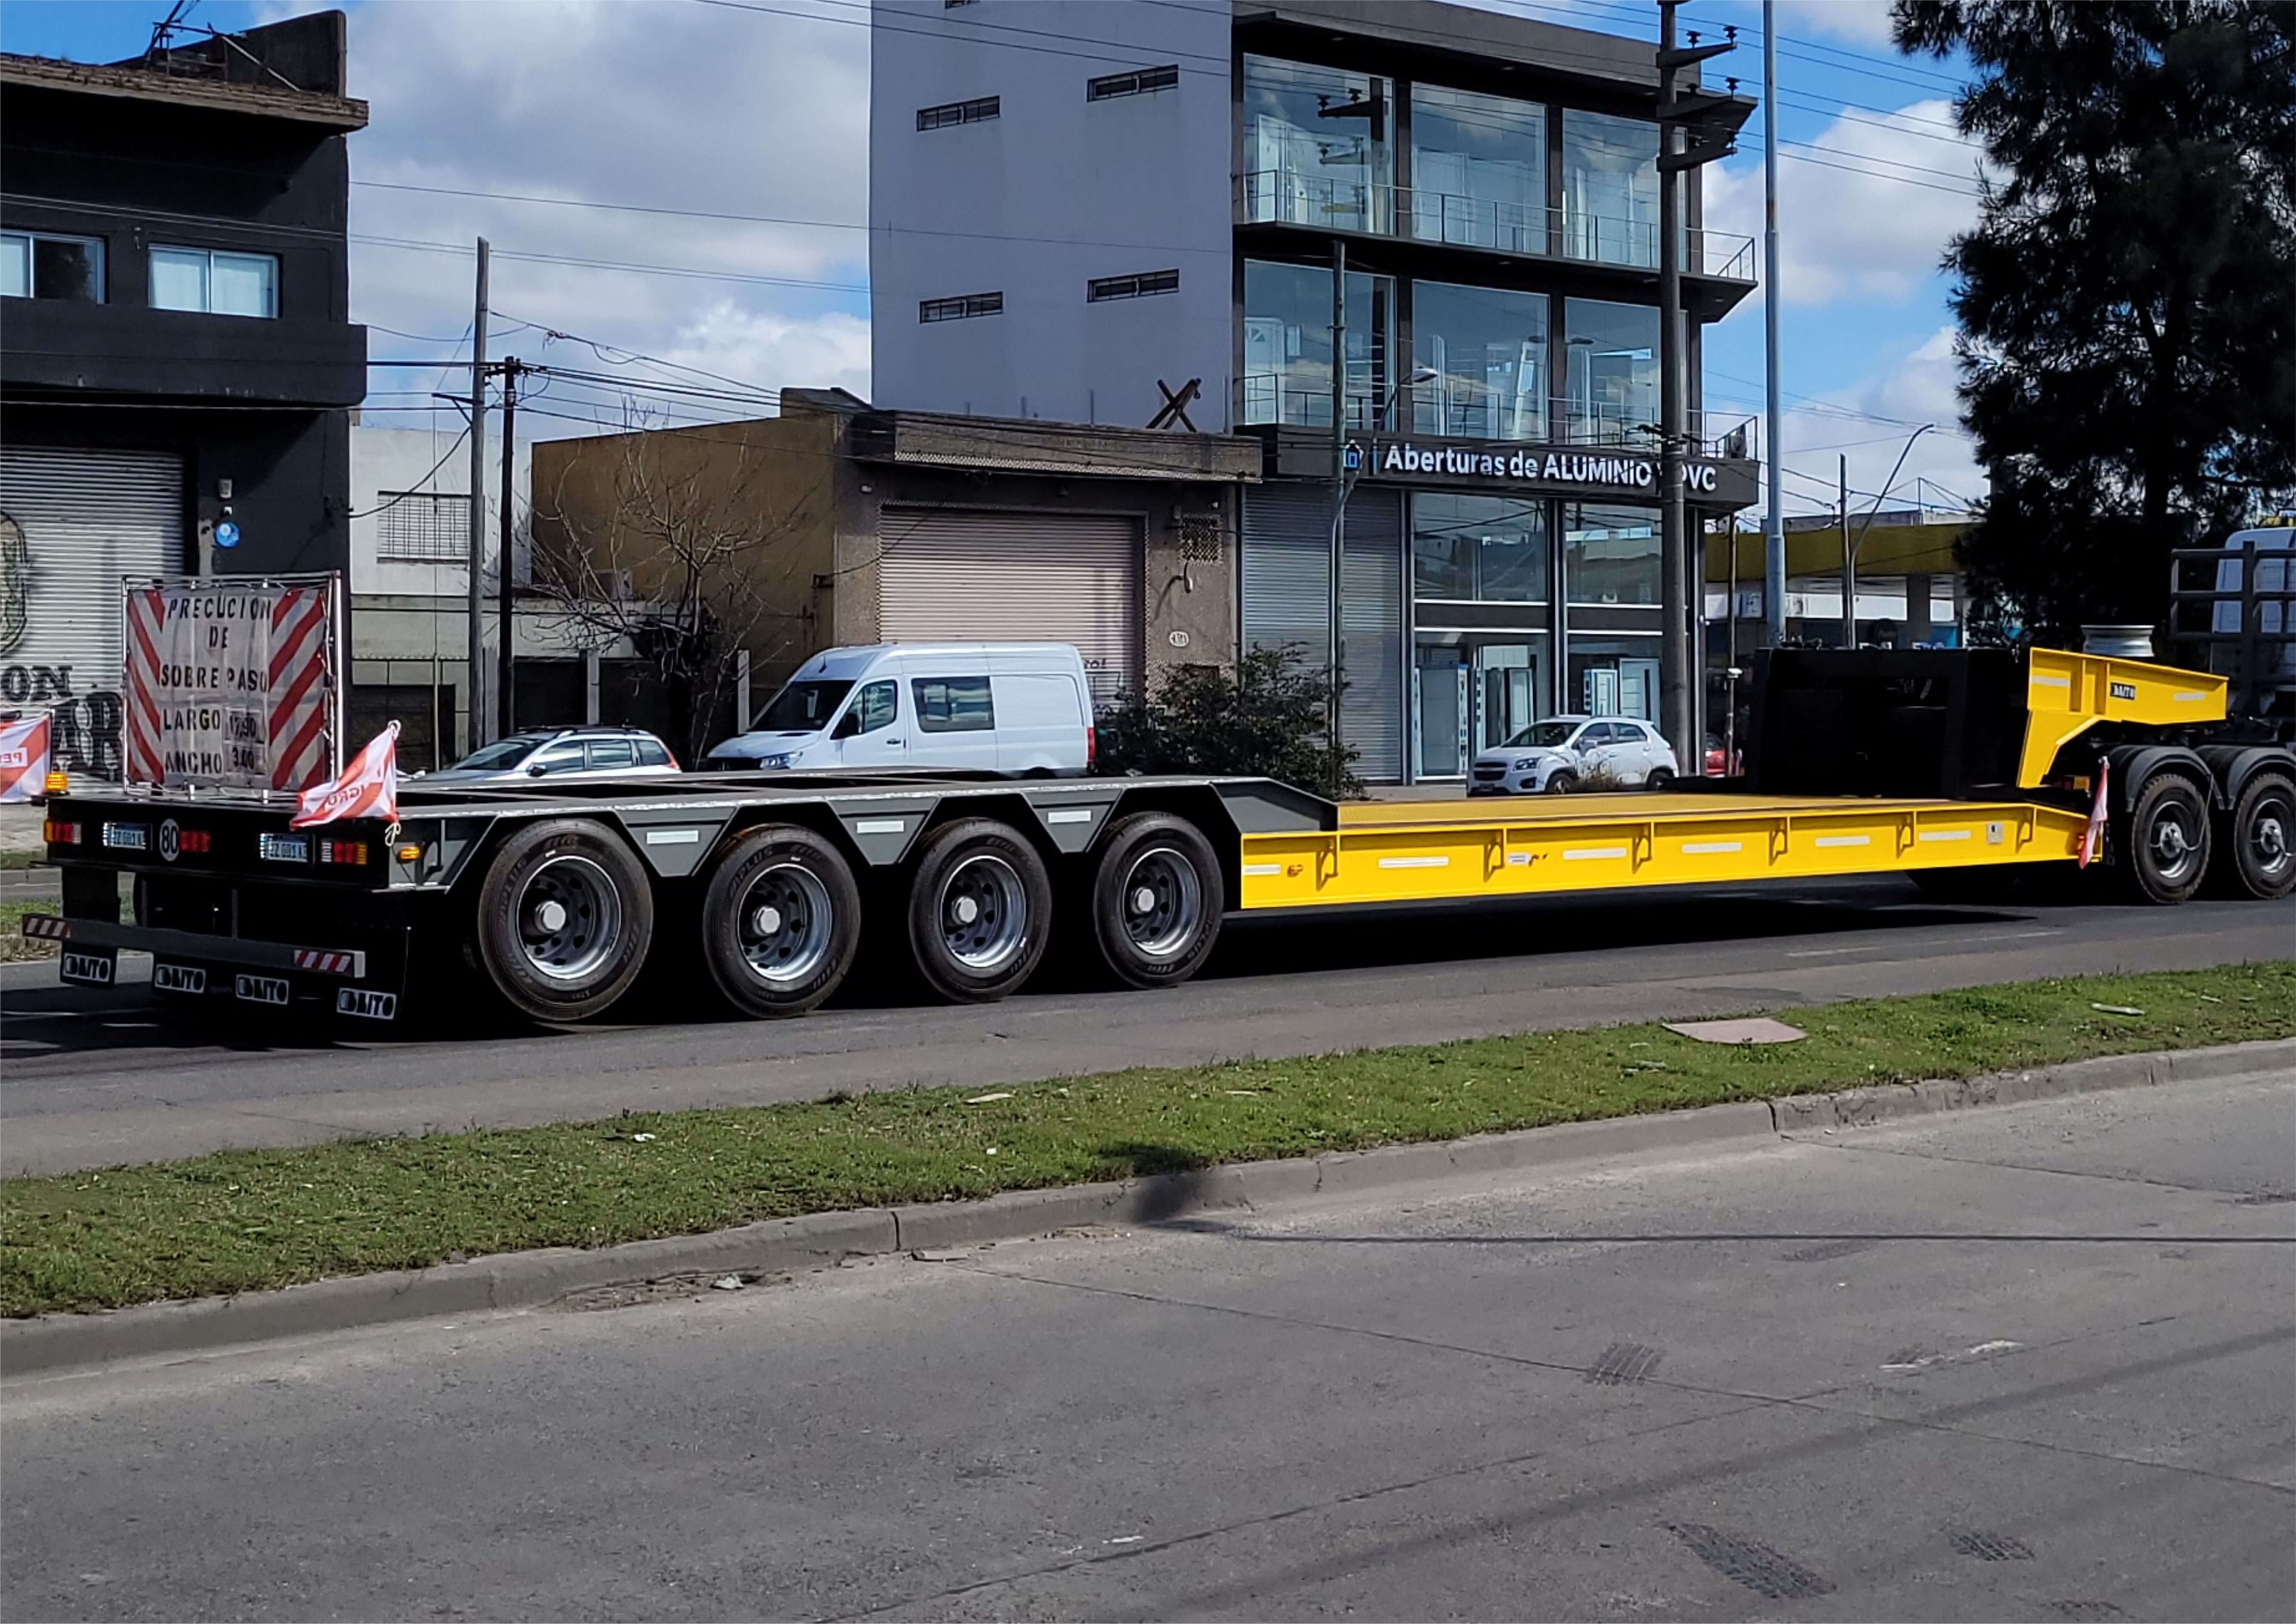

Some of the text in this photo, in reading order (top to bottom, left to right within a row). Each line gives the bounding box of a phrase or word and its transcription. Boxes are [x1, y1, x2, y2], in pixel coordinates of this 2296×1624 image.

[1384, 443, 1505, 476] Aberturas
[1510, 450, 1538, 478] de
[1544, 454, 1652, 486] ALUMINIO
[167, 594, 271, 620] PRECUCION
[209, 625, 228, 648] DE
[161, 663, 267, 693] SOBRE PASO
[163, 708, 220, 731] LARGO
[165, 751, 223, 774] ANCHO
[161, 825, 178, 854] 80
